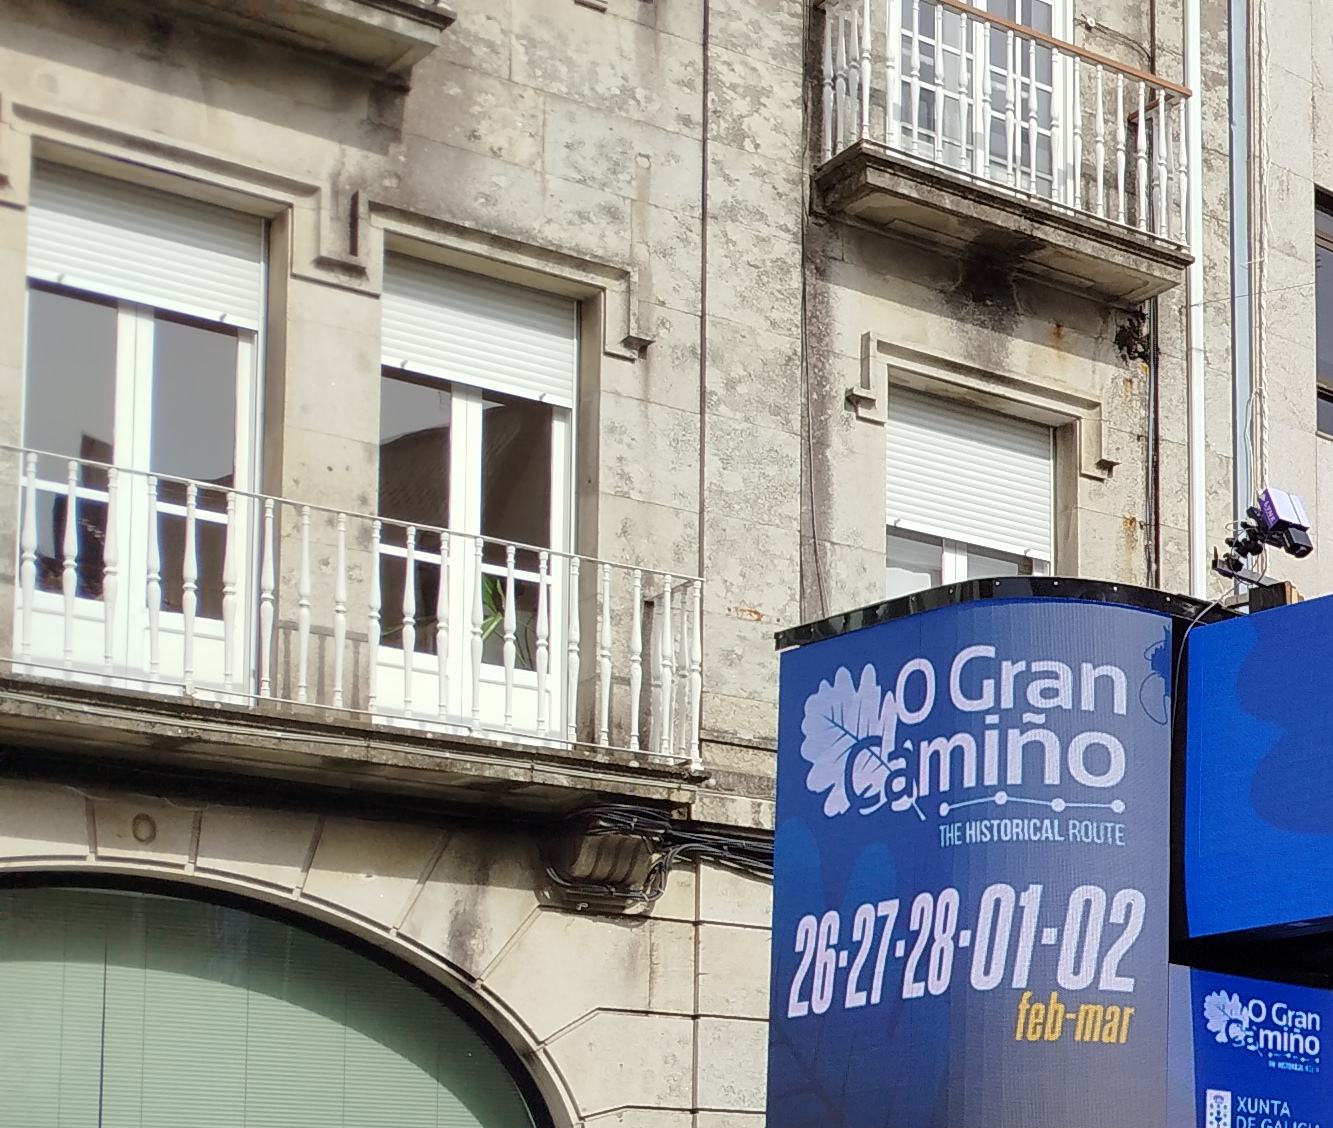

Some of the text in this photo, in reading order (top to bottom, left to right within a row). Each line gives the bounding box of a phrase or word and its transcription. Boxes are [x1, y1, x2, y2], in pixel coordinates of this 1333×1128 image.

[895, 645, 1127, 725] O Gran
[939, 818, 1127, 847] THE HISTORICAL ROUTE
[1015, 991, 1135, 1044] feb-mar
[1248, 999, 1320, 1031] O Gran
[1237, 1096, 1291, 1118] XUNTA
